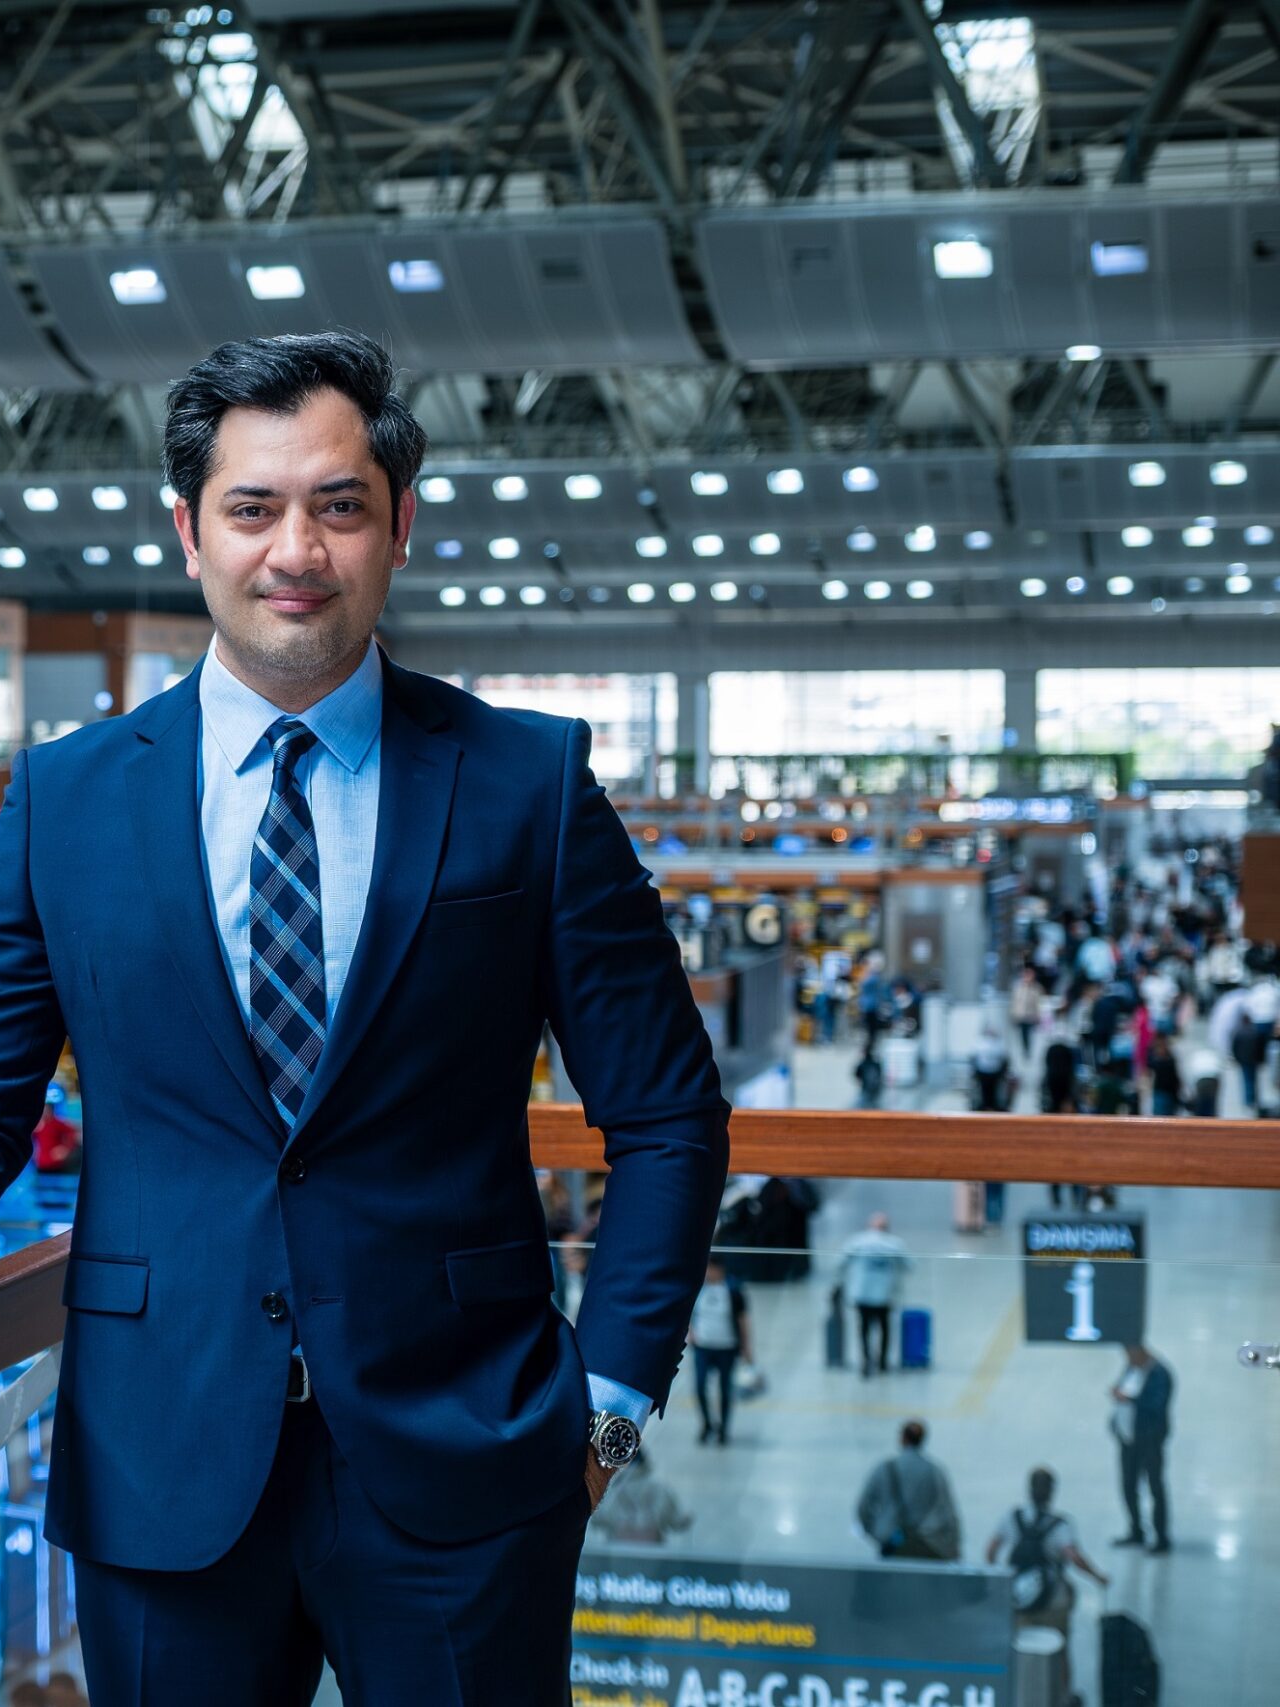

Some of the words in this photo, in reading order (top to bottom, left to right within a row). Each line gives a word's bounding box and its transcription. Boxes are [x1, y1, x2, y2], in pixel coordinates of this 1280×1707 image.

[599, 1571, 664, 1604] Hatlar
[667, 1575, 731, 1609] Giden
[731, 1578, 791, 1612] Yolcu
[573, 1607, 696, 1640] nternational
[699, 1613, 816, 1649] Departures
